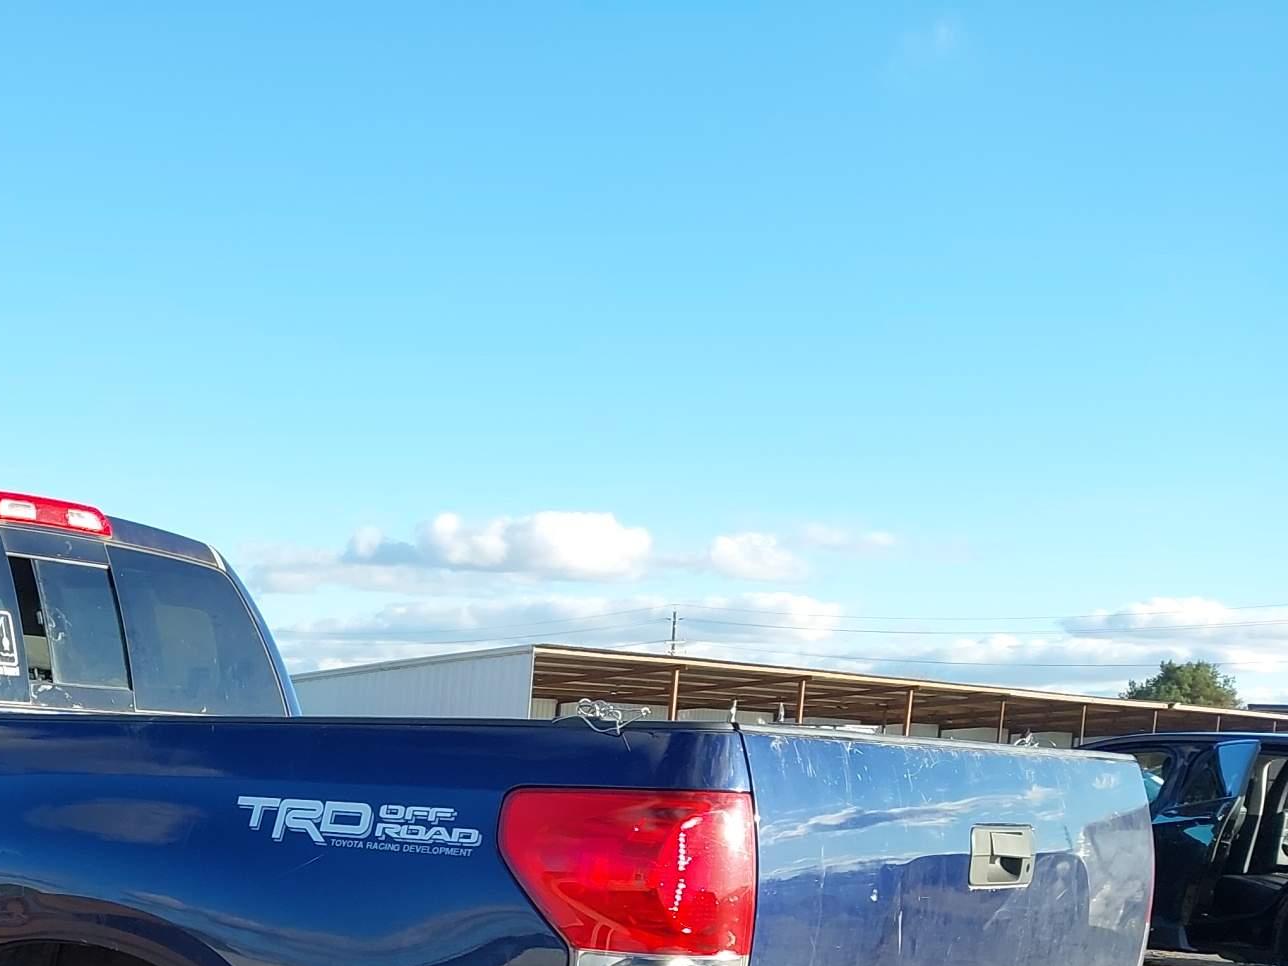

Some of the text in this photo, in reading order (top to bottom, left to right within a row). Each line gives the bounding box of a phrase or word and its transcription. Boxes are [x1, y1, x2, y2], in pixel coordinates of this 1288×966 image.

[237, 796, 374, 845] TRD
[379, 804, 457, 824] OFF
[375, 823, 483, 847] ROAD
[330, 838, 473, 857] TOYOTA RACING DEVELOPMENT
